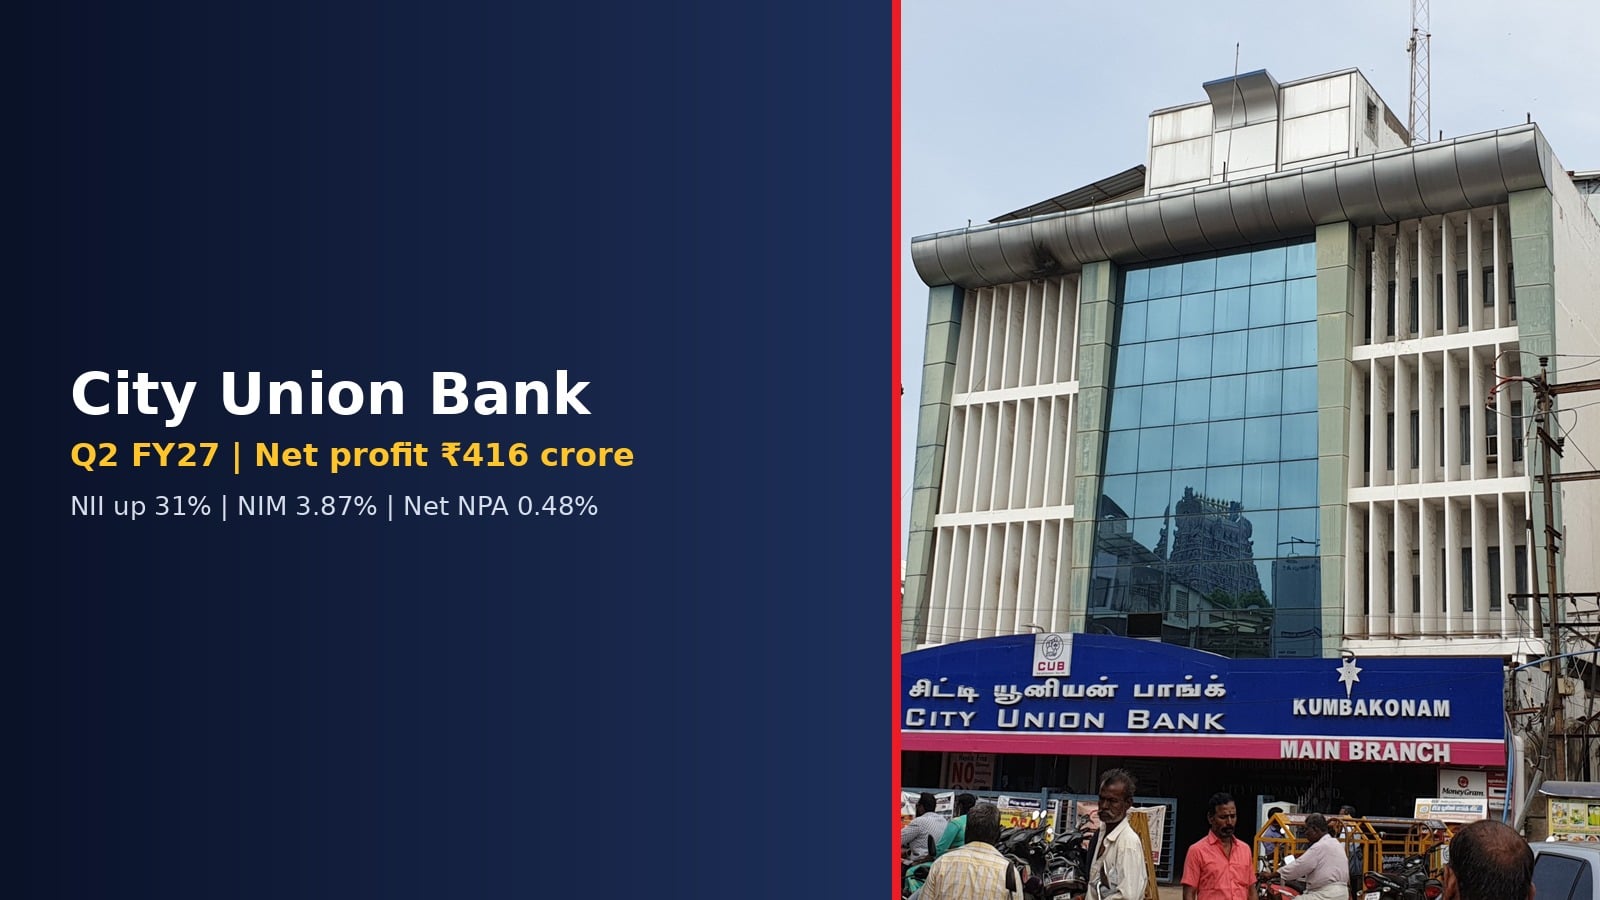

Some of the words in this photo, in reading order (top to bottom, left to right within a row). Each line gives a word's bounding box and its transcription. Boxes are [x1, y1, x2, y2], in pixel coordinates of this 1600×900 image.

[1038, 661, 1065, 671] CUB
[908, 677, 980, 702] சிட்டி
[993, 676, 1119, 705] யூனியன்
[1133, 674, 1227, 698] பாங்க்
[1293, 698, 1450, 718] KUMBAKONAM
[1280, 740, 1341, 761] MAIN
[1348, 741, 1451, 764] BRANCH
[952, 762, 974, 783] NO
[1441, 787, 1484, 797] MoneyGram
